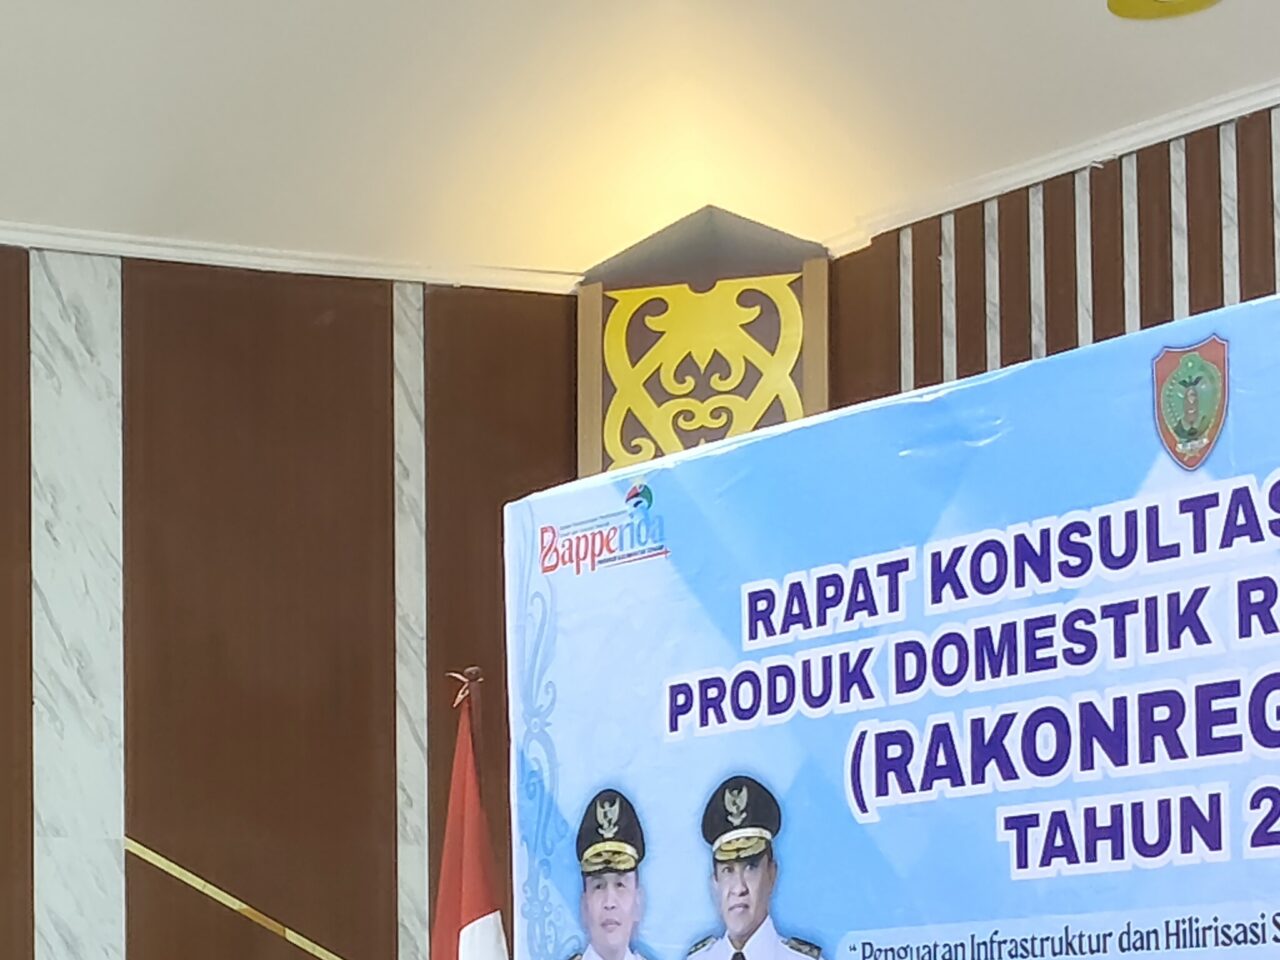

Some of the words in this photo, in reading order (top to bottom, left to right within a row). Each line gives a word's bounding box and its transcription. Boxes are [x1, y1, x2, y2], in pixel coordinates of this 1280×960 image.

[748, 558, 909, 641] RAPAT
[668, 647, 875, 733] PRODUK
[894, 586, 1212, 694] DOMESTIK
[1237, 576, 1280, 639] R
[850, 672, 1280, 814] (RAKONREG
[1004, 792, 1222, 870] TAHUN
[1249, 786, 1280, 848] 2
[1119, 921, 1160, 953] dan
[1164, 912, 1267, 950] Hilirisasi
